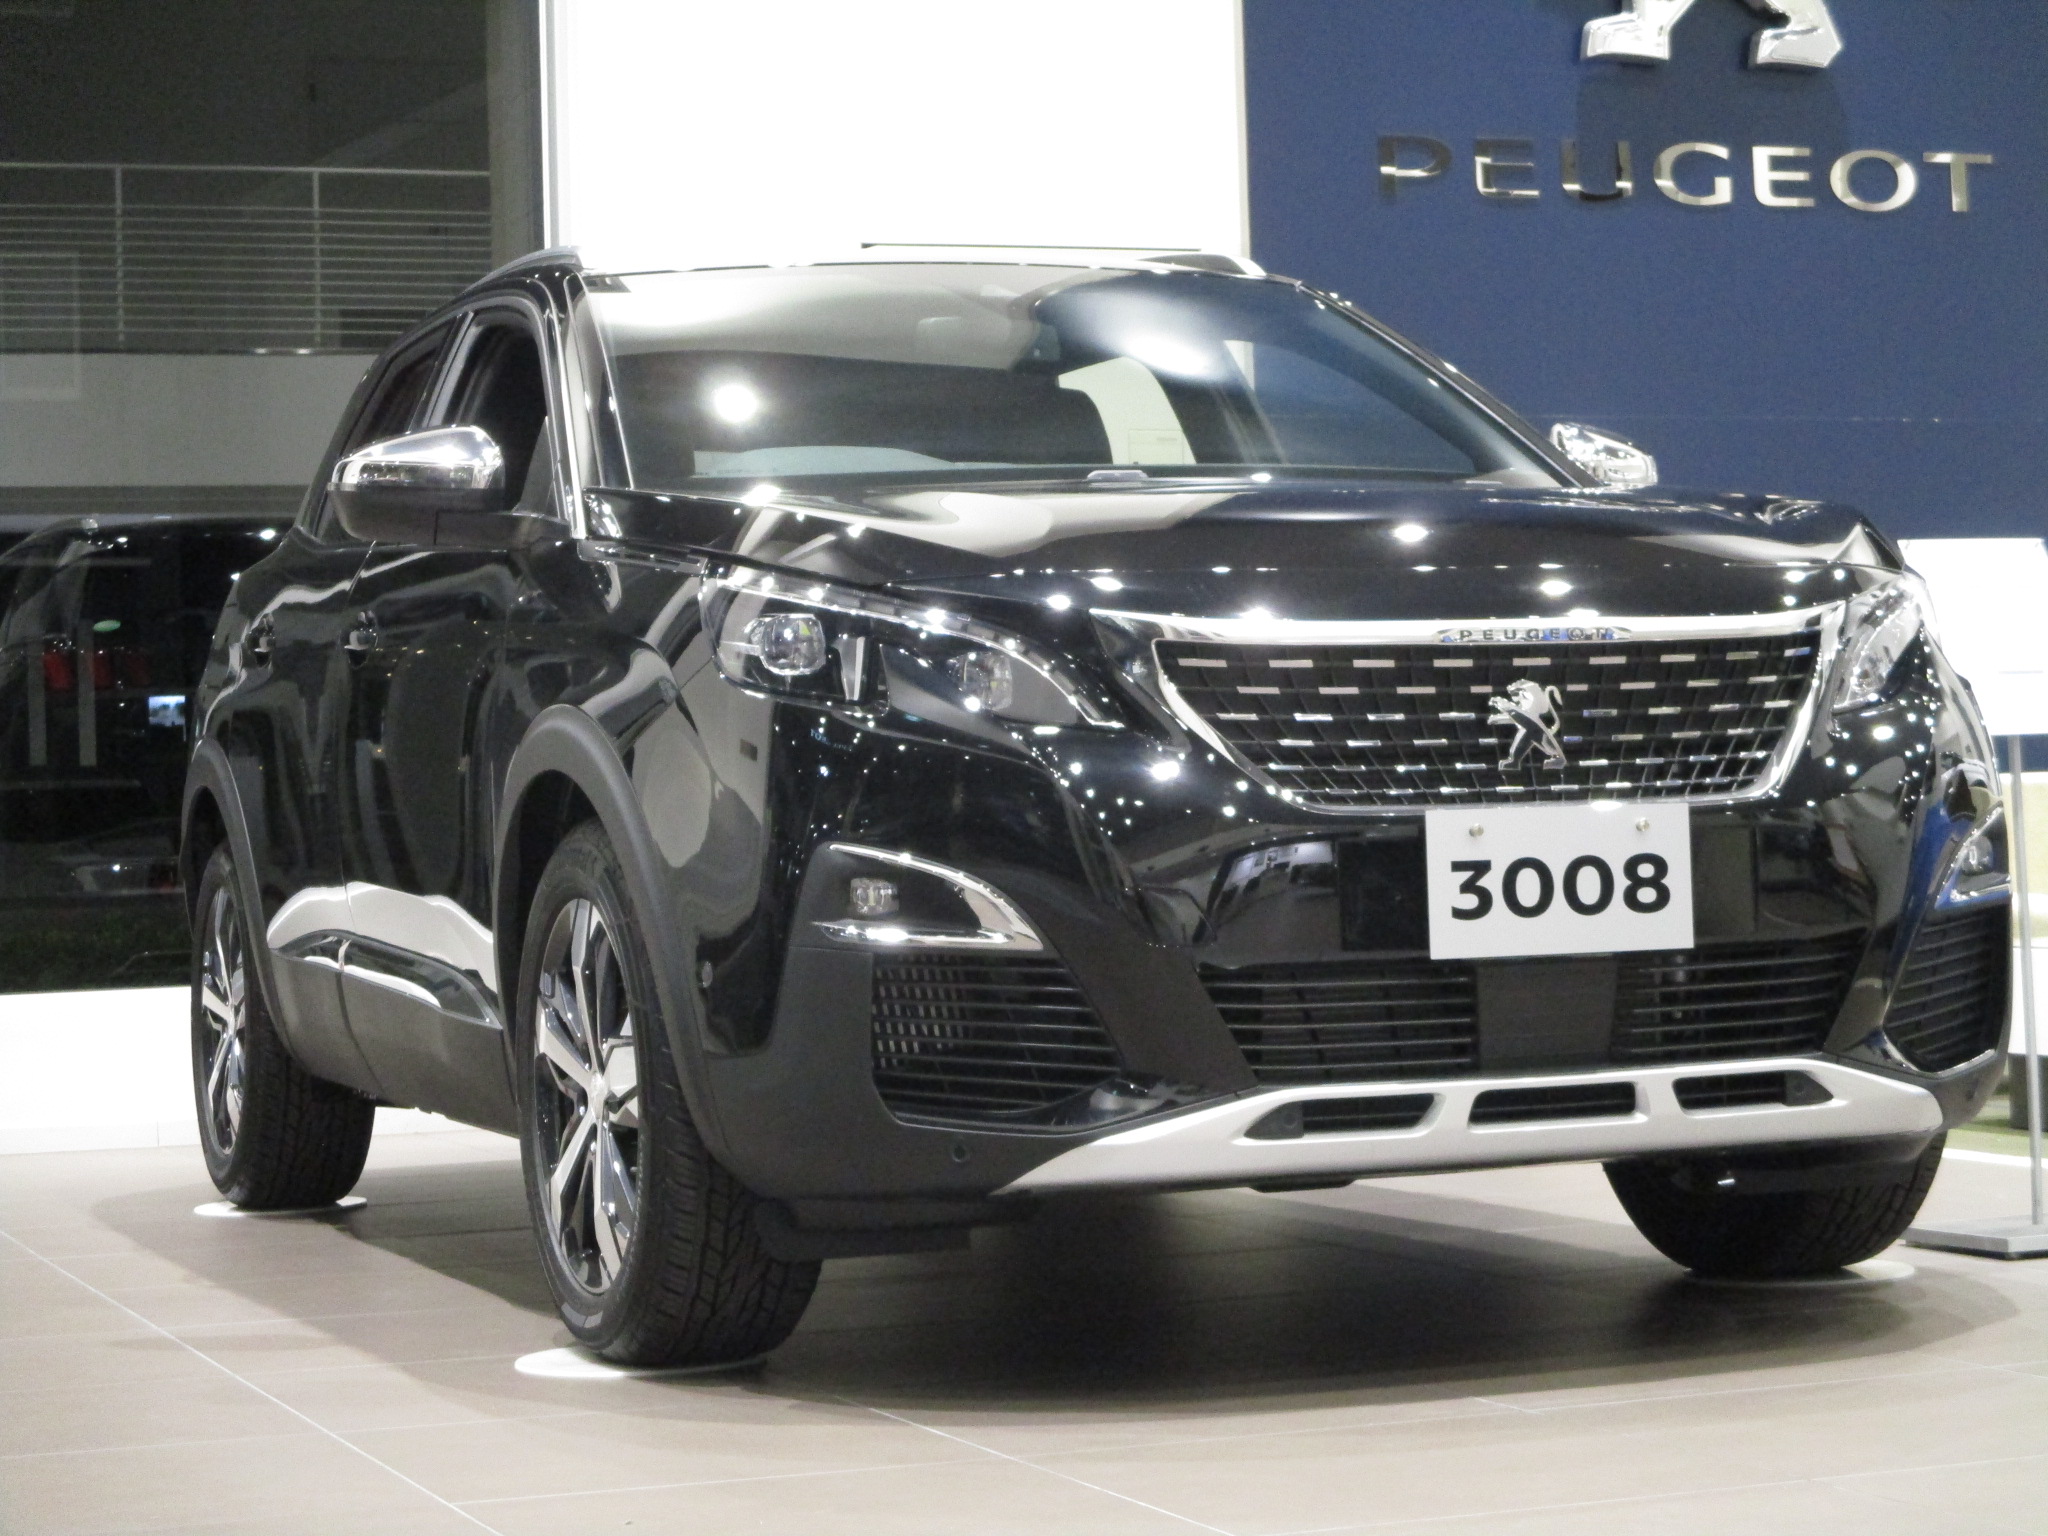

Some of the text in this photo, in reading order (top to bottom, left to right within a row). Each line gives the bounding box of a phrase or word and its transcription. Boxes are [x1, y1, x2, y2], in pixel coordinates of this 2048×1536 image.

[1377, 135, 1994, 213] PEUGEOT
[1459, 627, 1607, 641] PEUGEOT
[1451, 853, 1671, 921] 3008
